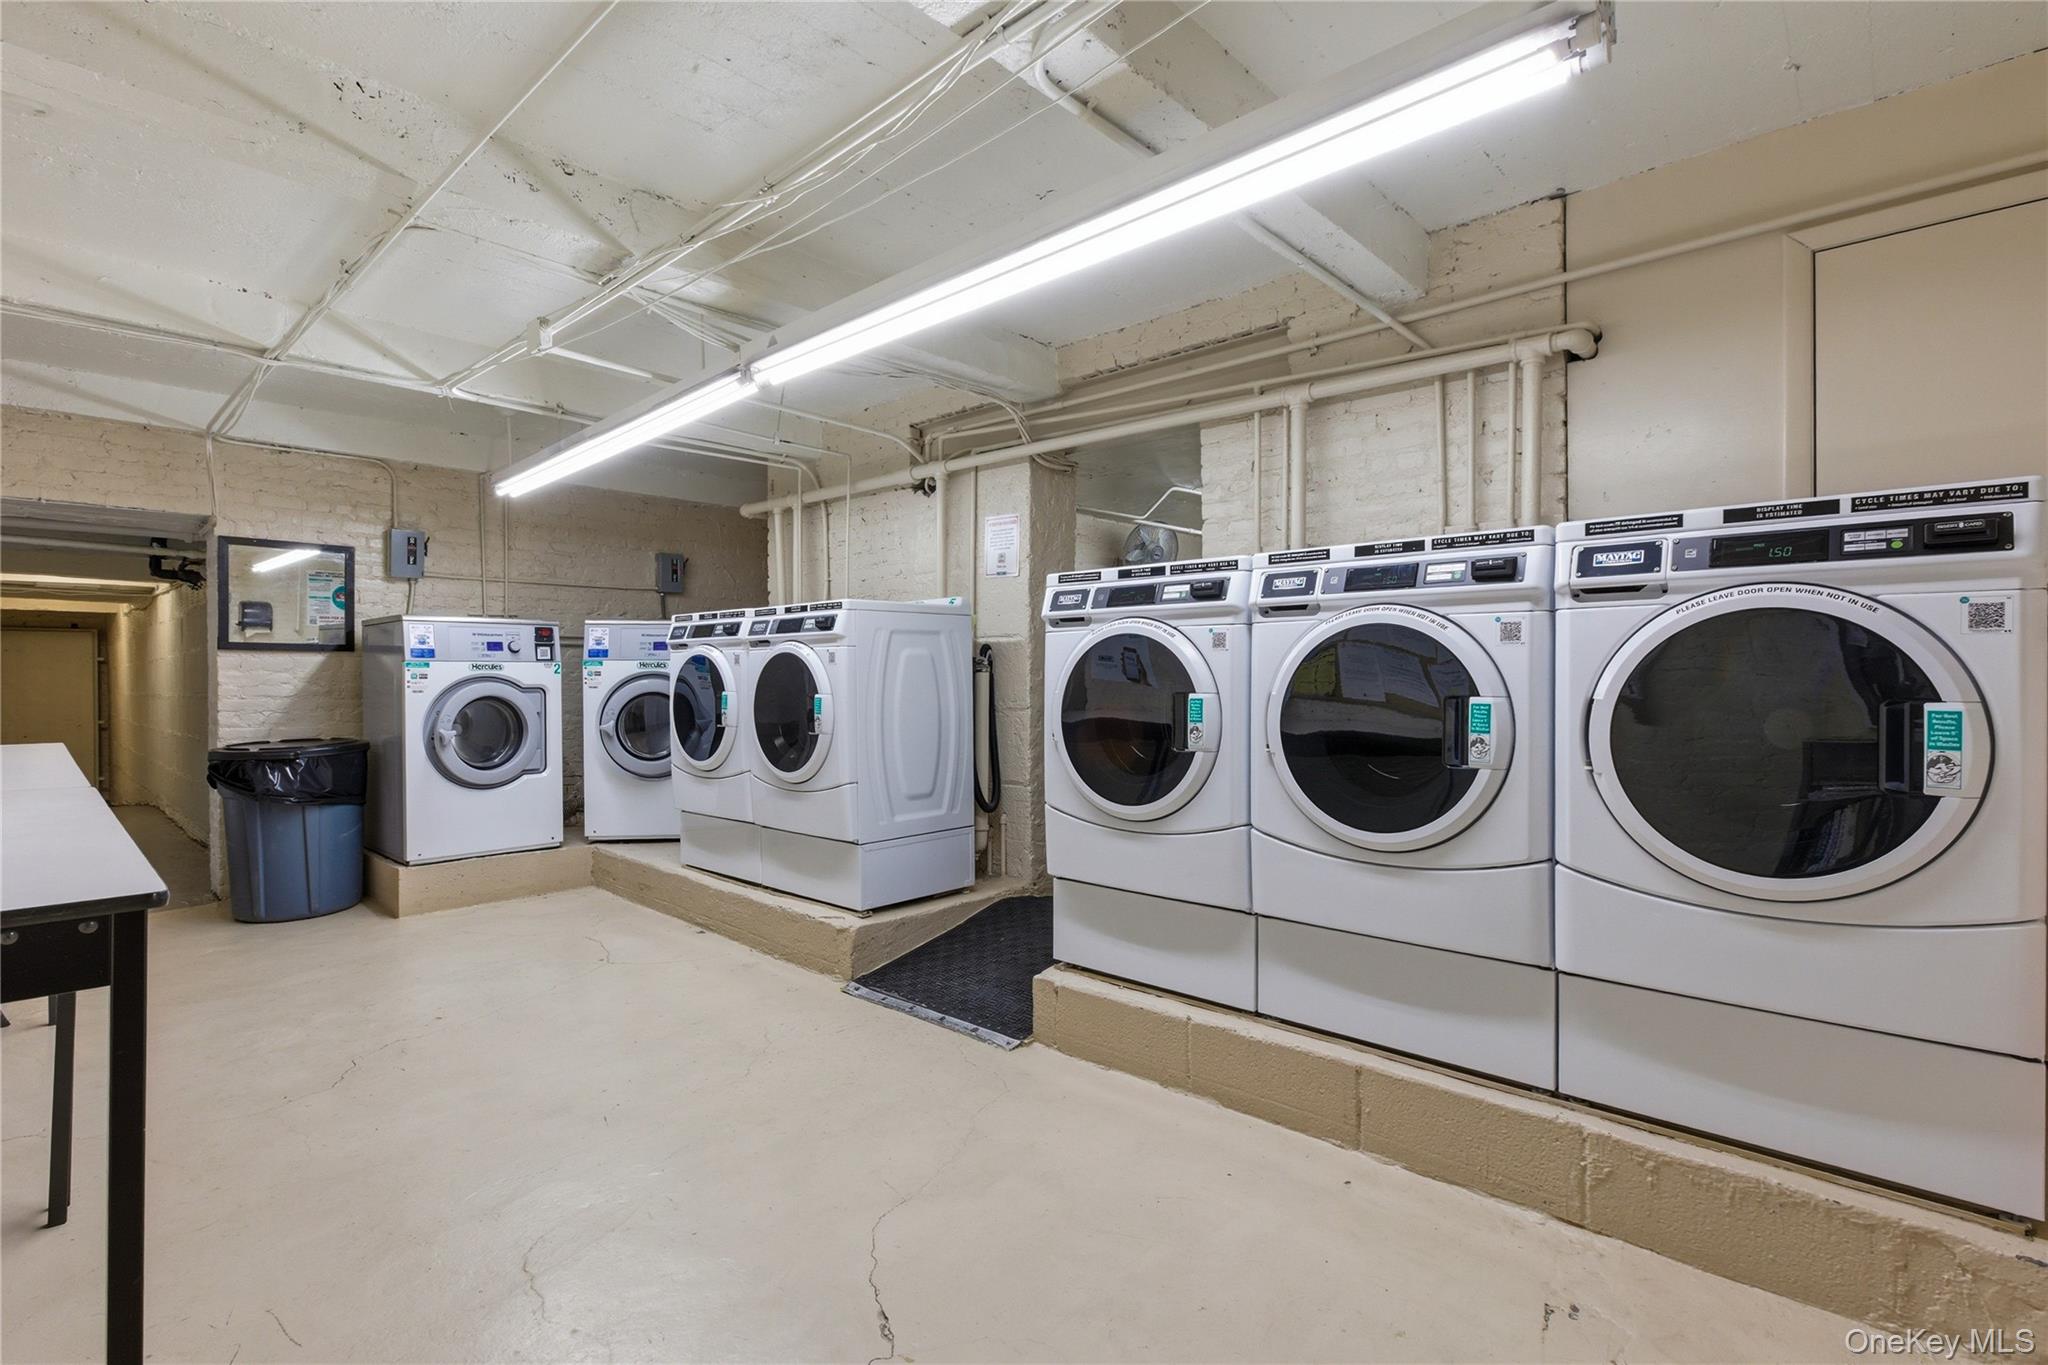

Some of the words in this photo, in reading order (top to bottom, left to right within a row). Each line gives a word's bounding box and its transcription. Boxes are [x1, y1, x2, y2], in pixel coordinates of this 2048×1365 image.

[1855, 497, 1885, 505] CYCLE
[1889, 493, 1919, 502] TIMES
[1923, 491, 1944, 499] MAY
[1949, 488, 1976, 497] VARY
[1980, 486, 2001, 494] DUE
[2005, 484, 2024, 492] TO:
[1765, 510, 1803, 518] ESTIMATED
[1595, 551, 1641, 561] MAYTAG
[1676, 600, 1706, 615] PLEASE
[1708, 591, 1735, 603] LEAVE
[1737, 588, 1764, 596] DOOR
[1795, 587, 1824, 597] WHEN
[1826, 591, 1847, 601] NOT
[1848, 597, 1859, 606] IN
[1860, 602, 1881, 614] USE
[471, 663, 503, 671] Hercules
[553, 663, 561, 675] 2
